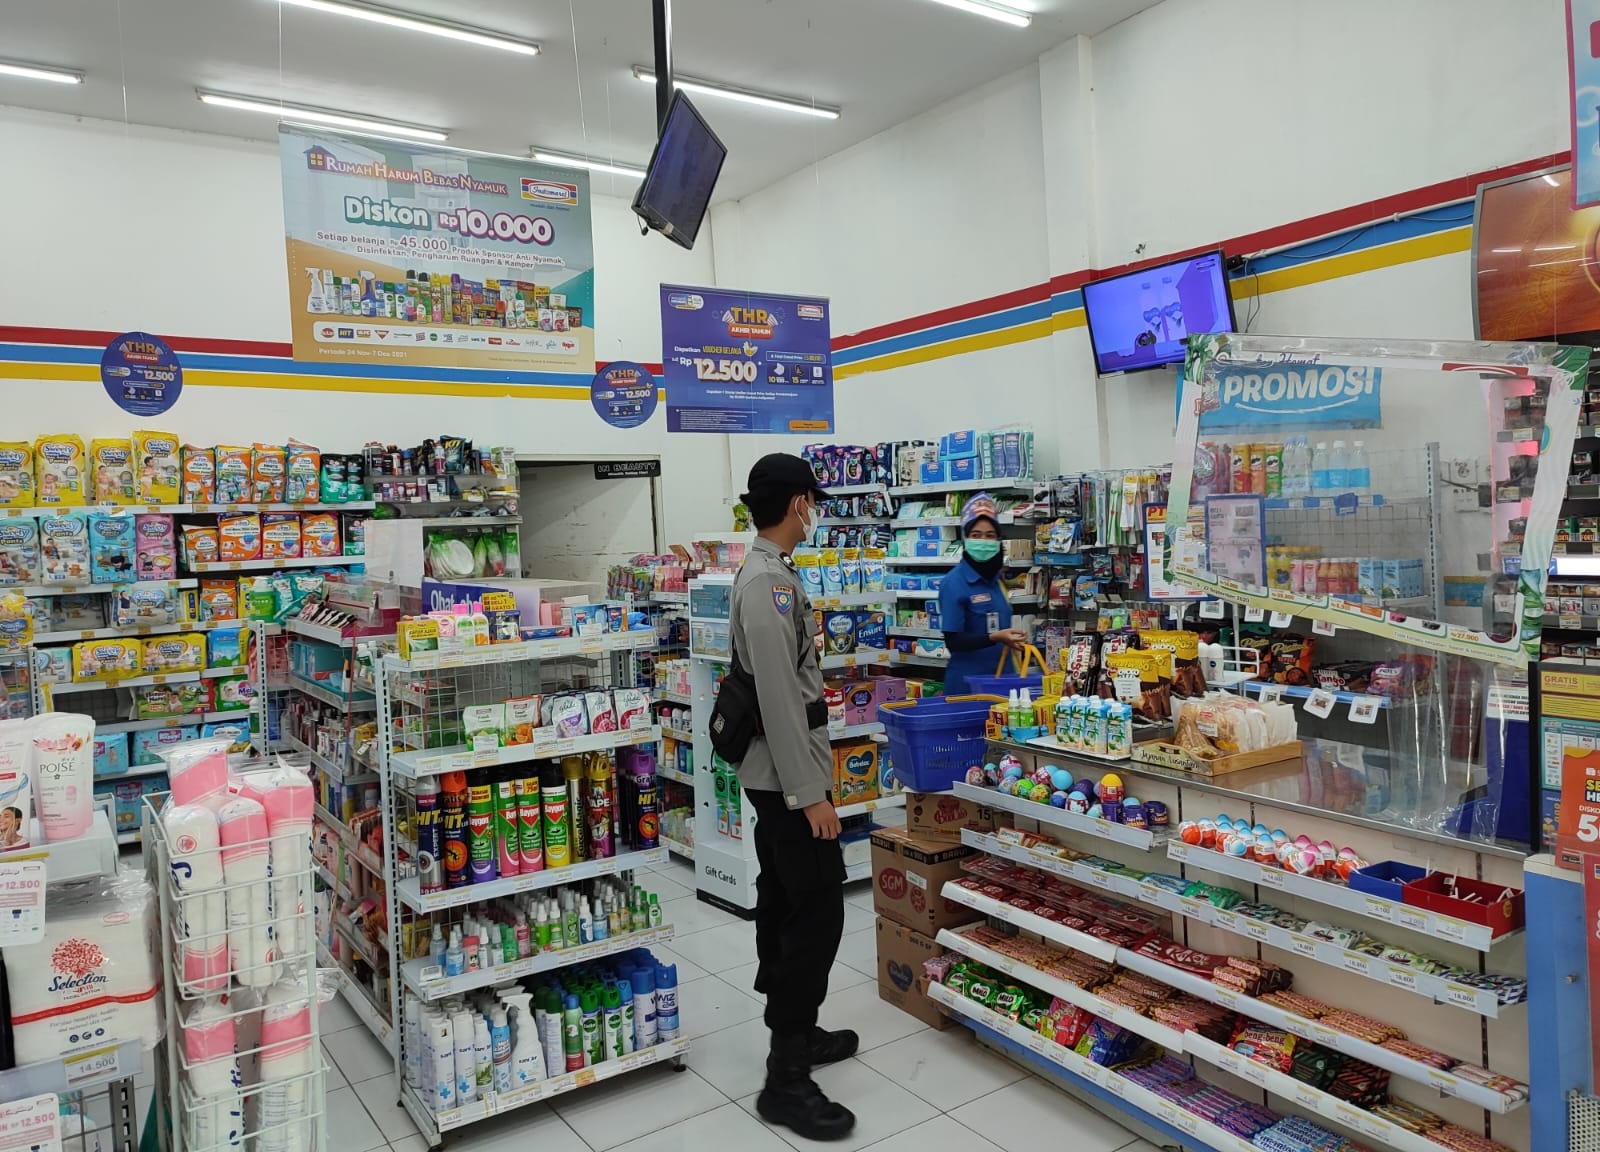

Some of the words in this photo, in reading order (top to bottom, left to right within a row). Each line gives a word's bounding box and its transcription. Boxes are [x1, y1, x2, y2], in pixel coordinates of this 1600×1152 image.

[326, 153, 373, 178] RUMAH
[374, 159, 420, 184] HARUM
[423, 169, 459, 189] BEBAS
[460, 175, 508, 196] NYAMUK
[344, 196, 430, 228] Diskon
[317, 231, 349, 244] Setiap
[351, 234, 385, 246] belanja
[452, 246, 480, 256] Produk
[412, 251, 459, 263] Pengharum
[460, 255, 495, 266] Ruangan
[505, 258, 535, 269] Kamper
[731, 306, 768, 324] THR
[126, 341, 156, 354] THR
[143, 370, 175, 382] 12.500
[612, 369, 636, 378] THR
[680, 357, 693, 368] Rp
[694, 358, 758, 382] 12.500
[1223, 366, 1376, 404] PROMOSI
[625, 390, 651, 398] 12.500
[44, 443, 75, 456] Sweety
[100, 449, 130, 459] Sweety
[613, 462, 657, 472] BEAUTY
[431, 590, 455, 611] Obat
[858, 625, 884, 638] Ensure
[1070, 638, 1088, 680] Tango
[1315, 674, 1345, 687] Tango
[1544, 675, 1578, 685] GRATIS
[39, 762, 76, 774] POISE
[519, 807, 539, 818] Baygon
[544, 804, 565, 813] Baygon
[977, 808, 992, 821] 15
[416, 809, 441, 825] HIT
[705, 865, 717, 878] Gift
[718, 870, 736, 886] Cards
[6, 880, 40, 890] 12.500
[882, 874, 904, 891] SGM
[48, 971, 108, 992] Selection
[971, 987, 988, 998] MILO
[998, 993, 1014, 1003] MILO
[1244, 1031, 1285, 1046] beng-beng
[80, 1056, 116, 1073] 14.500
[21, 1111, 55, 1128] 12.500
